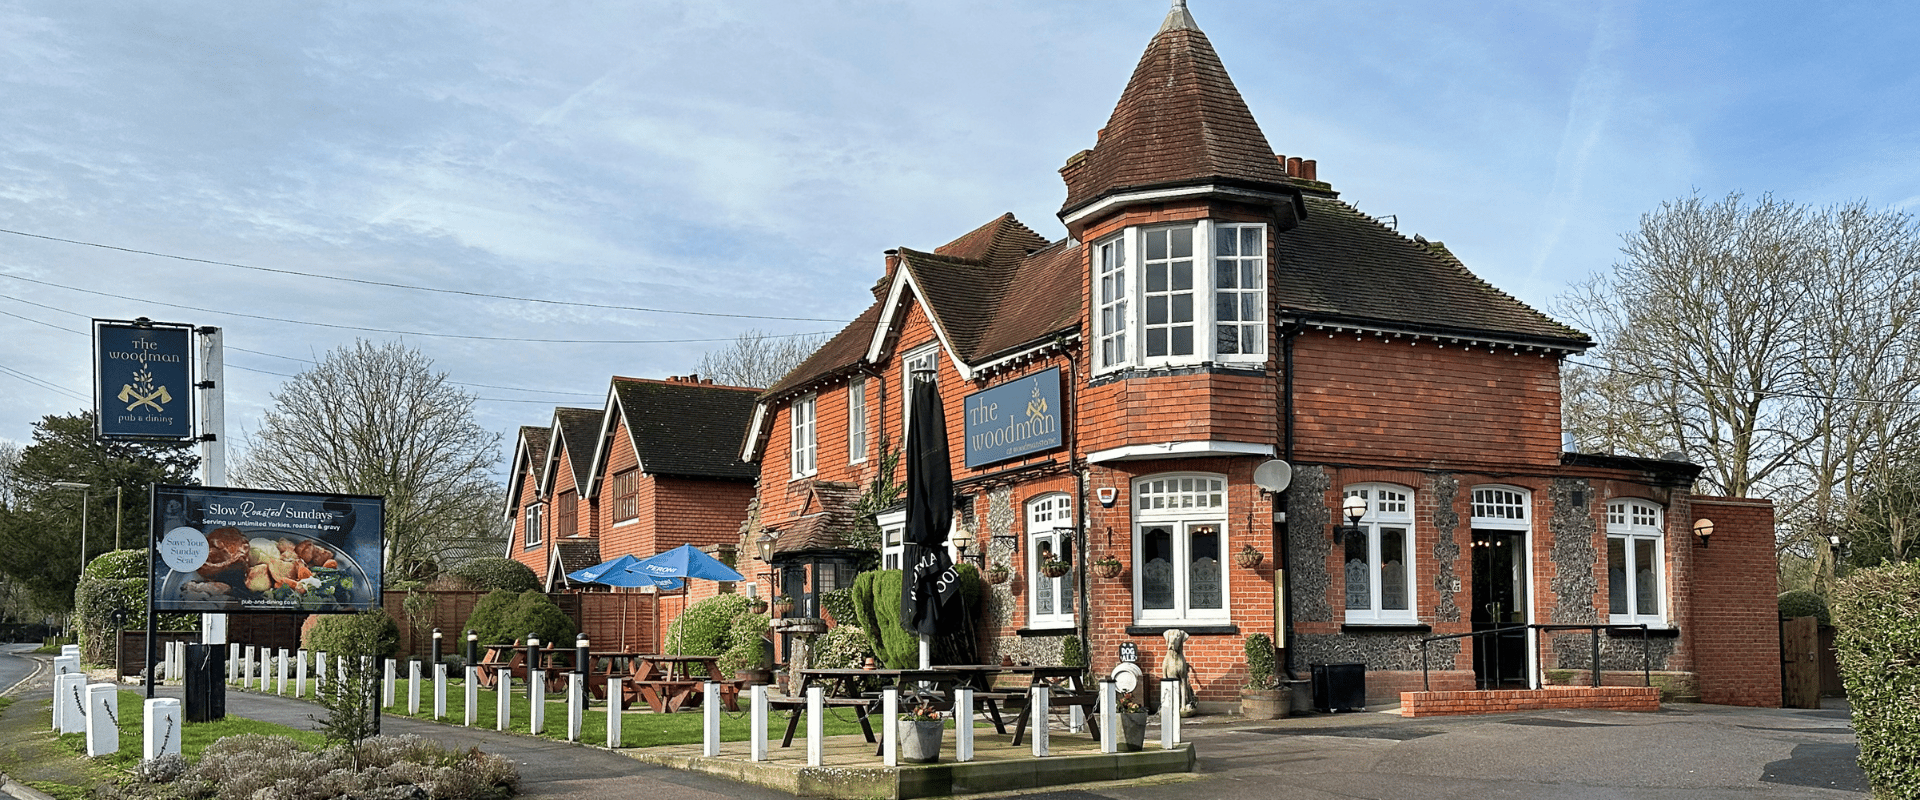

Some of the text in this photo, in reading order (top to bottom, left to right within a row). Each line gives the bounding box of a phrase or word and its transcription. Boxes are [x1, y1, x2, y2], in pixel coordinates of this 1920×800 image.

[132, 338, 158, 350] The
[109, 350, 180, 363] woodman
[970, 397, 998, 426] The
[118, 414, 136, 423] pub
[145, 414, 173, 426] dining
[972, 414, 1056, 452] woodman
[209, 501, 333, 523] Slow Roasted Sundays
[202, 518, 227, 527] Serving
[268, 521, 291, 529] Yorkies,
[292, 522, 316, 530] roasties
[323, 524, 341, 532] gravy
[166, 539, 205, 547] Save Your
[170, 548, 199, 557] Sunday
[176, 556, 194, 564] Seat
[646, 564, 678, 573] PERONI
[1121, 647, 1135, 655] DOG
